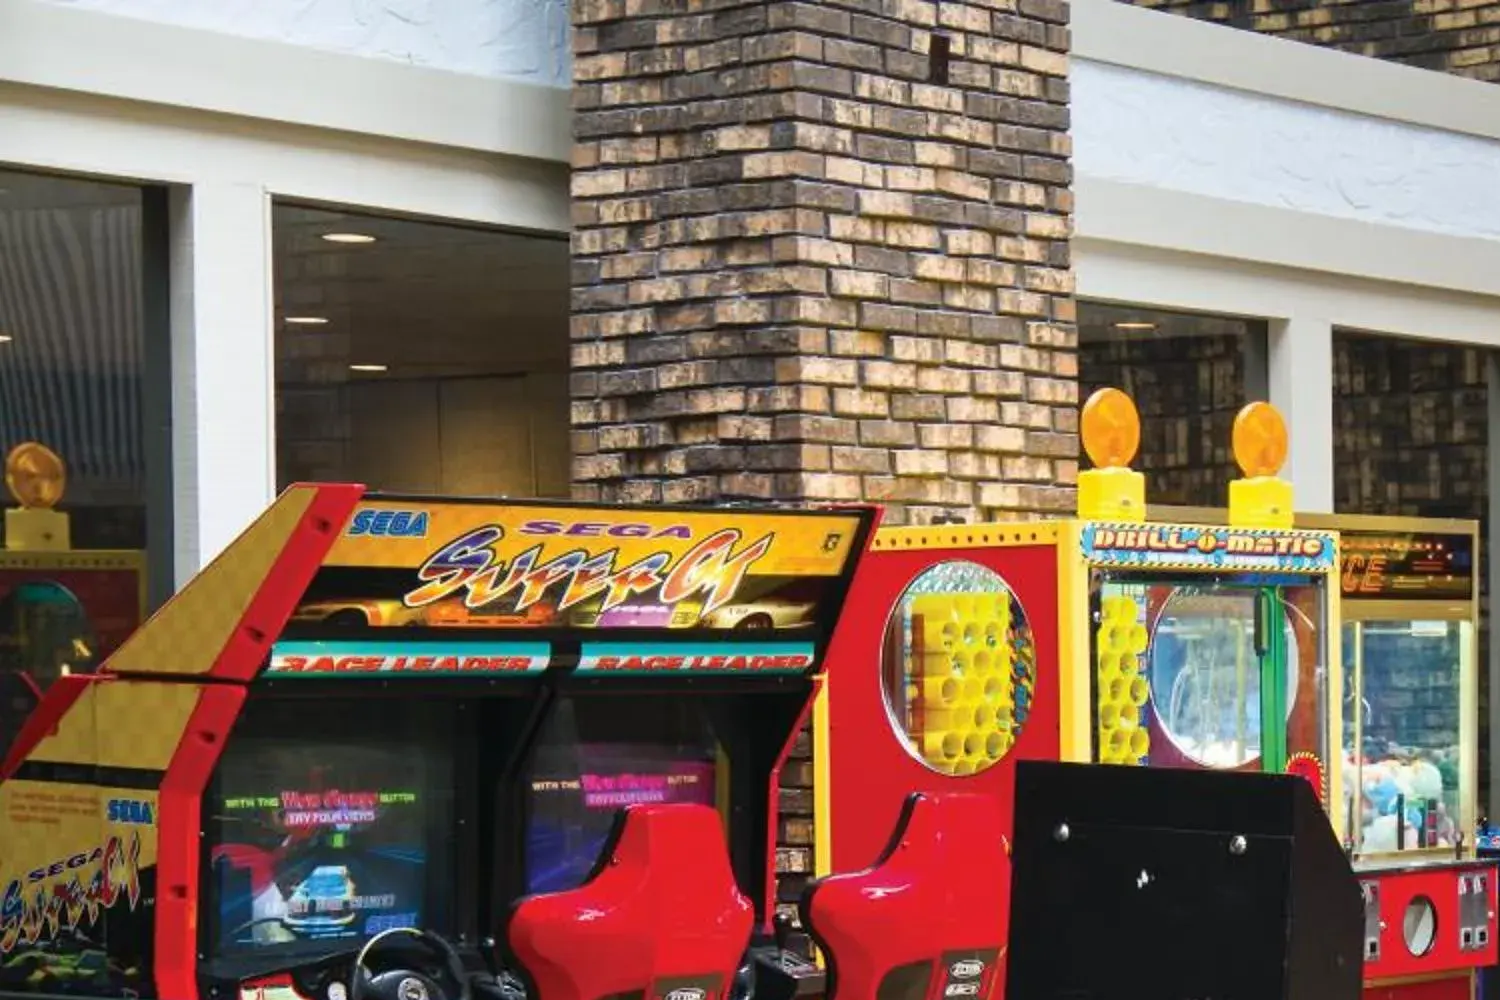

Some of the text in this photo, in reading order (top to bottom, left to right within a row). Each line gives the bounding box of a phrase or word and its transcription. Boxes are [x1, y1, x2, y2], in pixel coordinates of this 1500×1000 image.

[346, 508, 431, 537] SEGA
[519, 521, 691, 540] SEGA
[403, 523, 777, 618] SUPER GT
[278, 655, 532, 673] RACE LEADER
[593, 654, 810, 670] RACE LEADER
[108, 799, 153, 825] SEGA
[28, 847, 103, 883] SEGA
